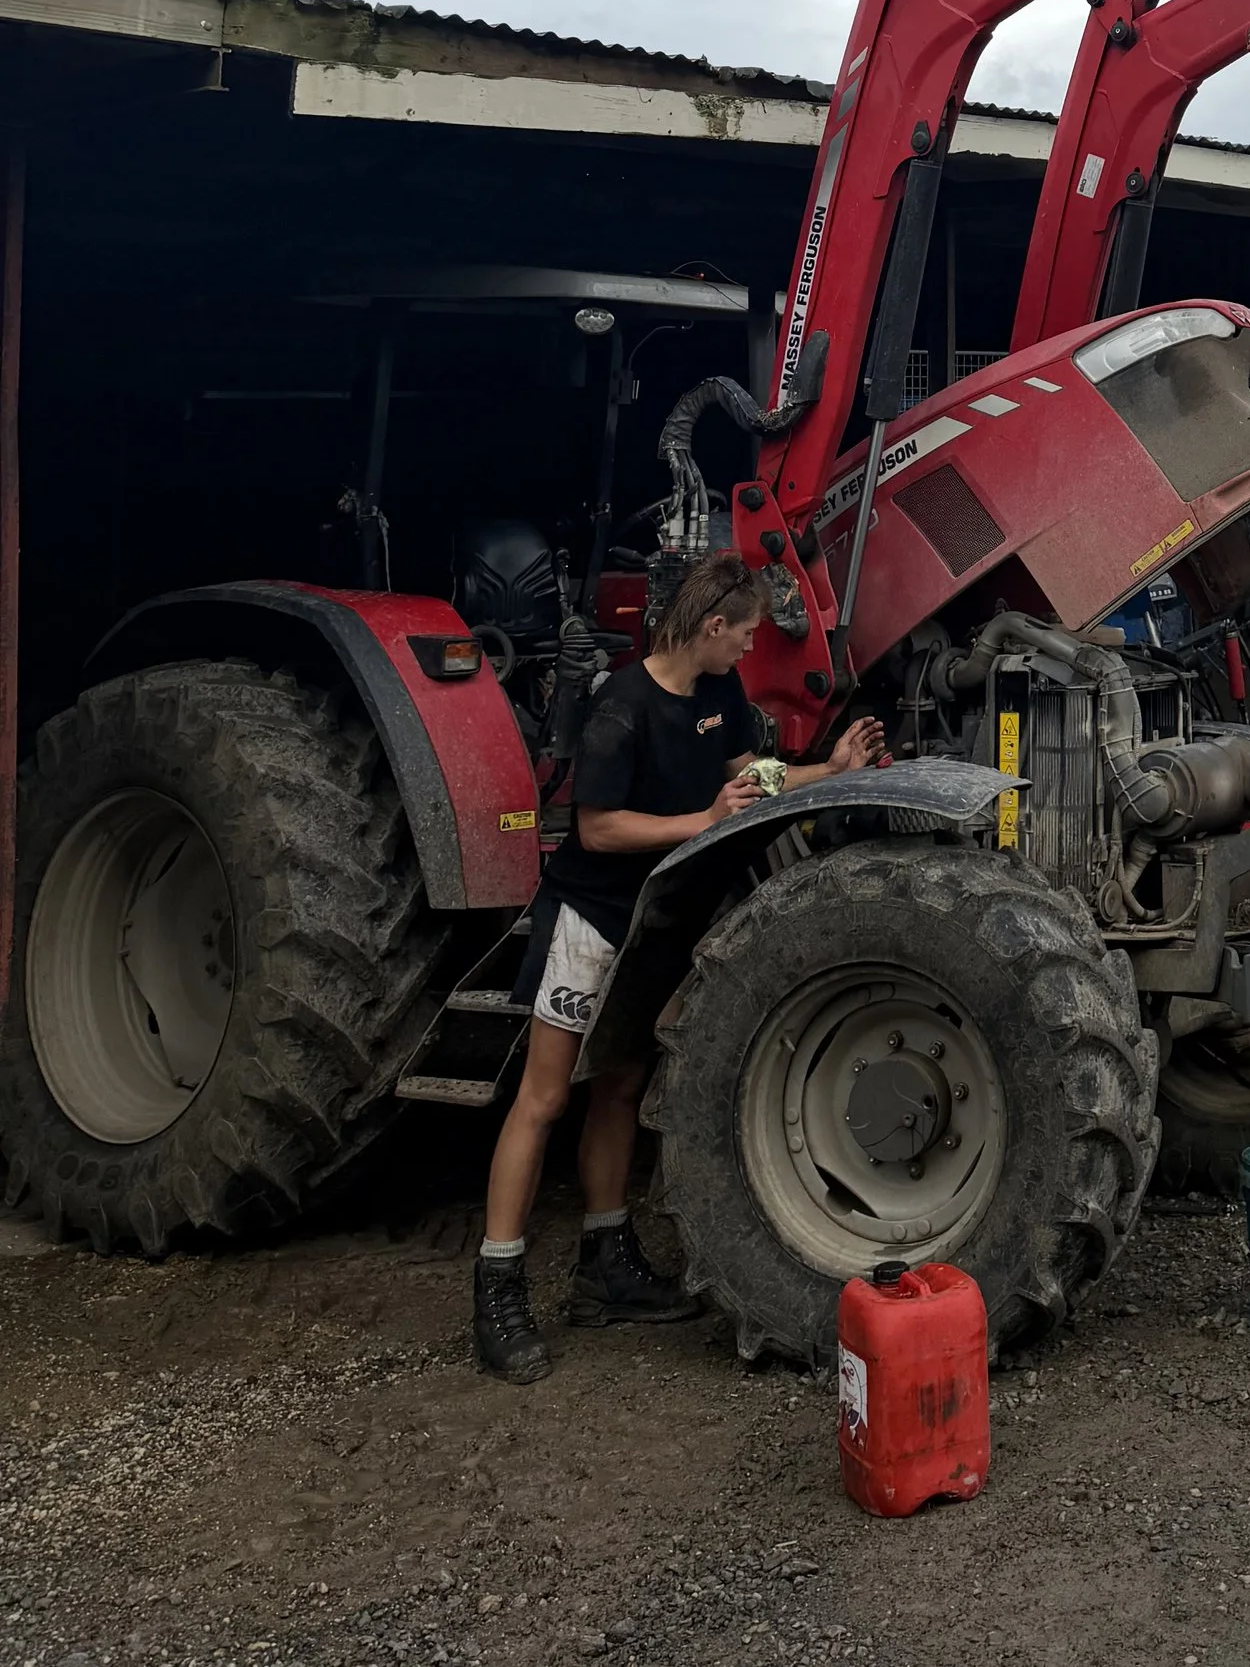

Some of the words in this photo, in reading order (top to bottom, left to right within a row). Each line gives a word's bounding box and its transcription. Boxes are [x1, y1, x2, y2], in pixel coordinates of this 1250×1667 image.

[781, 311, 805, 391] MASSEY
[797, 206, 827, 305] FERGUSON
[840, 439, 918, 502] FERUSON
